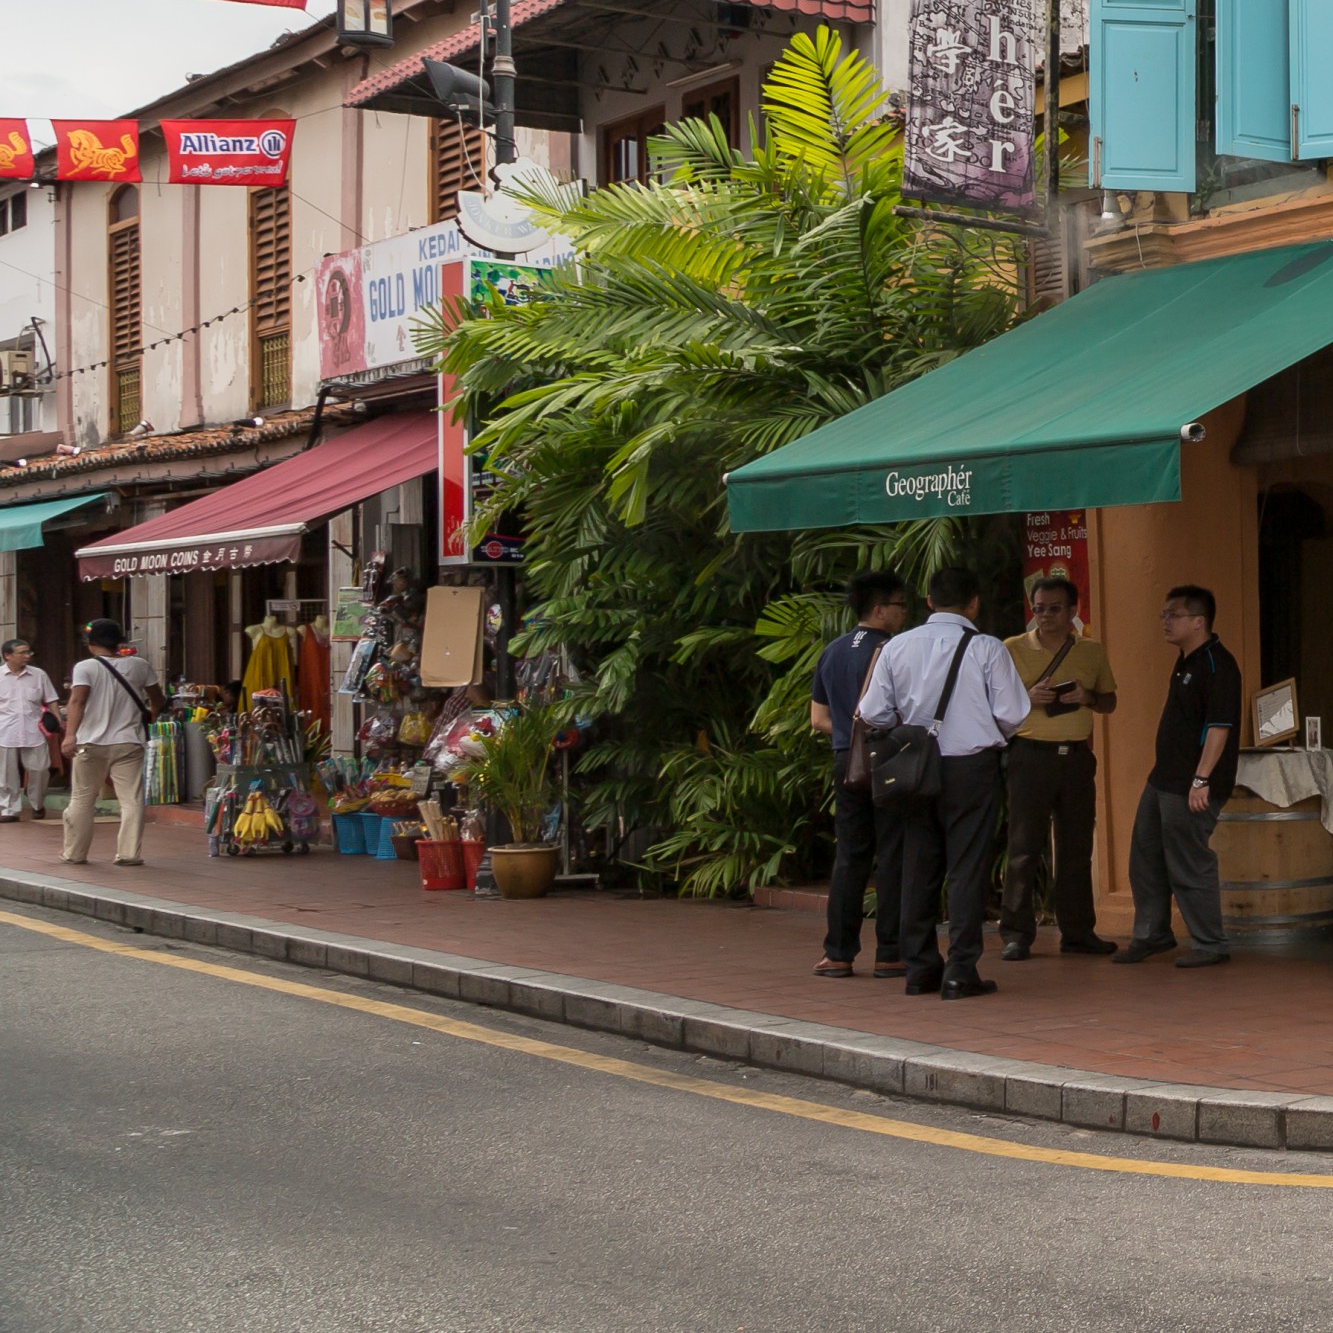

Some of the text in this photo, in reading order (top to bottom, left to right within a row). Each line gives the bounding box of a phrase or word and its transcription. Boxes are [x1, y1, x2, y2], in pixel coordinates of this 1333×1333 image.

[180, 133, 259, 154] Allianz
[418, 229, 461, 262] KEDAI
[369, 272, 405, 323] GOLD
[886, 465, 972, 501] Geographér
[947, 489, 970, 506] Café
[1027, 512, 1050, 527] Fresh
[1027, 526, 1088, 544] Veggie & Fruits
[115, 557, 138, 573] GOLD
[140, 553, 167, 570] MOON
[170, 550, 199, 567] COINS
[1028, 543, 1072, 559] Yee Sang
